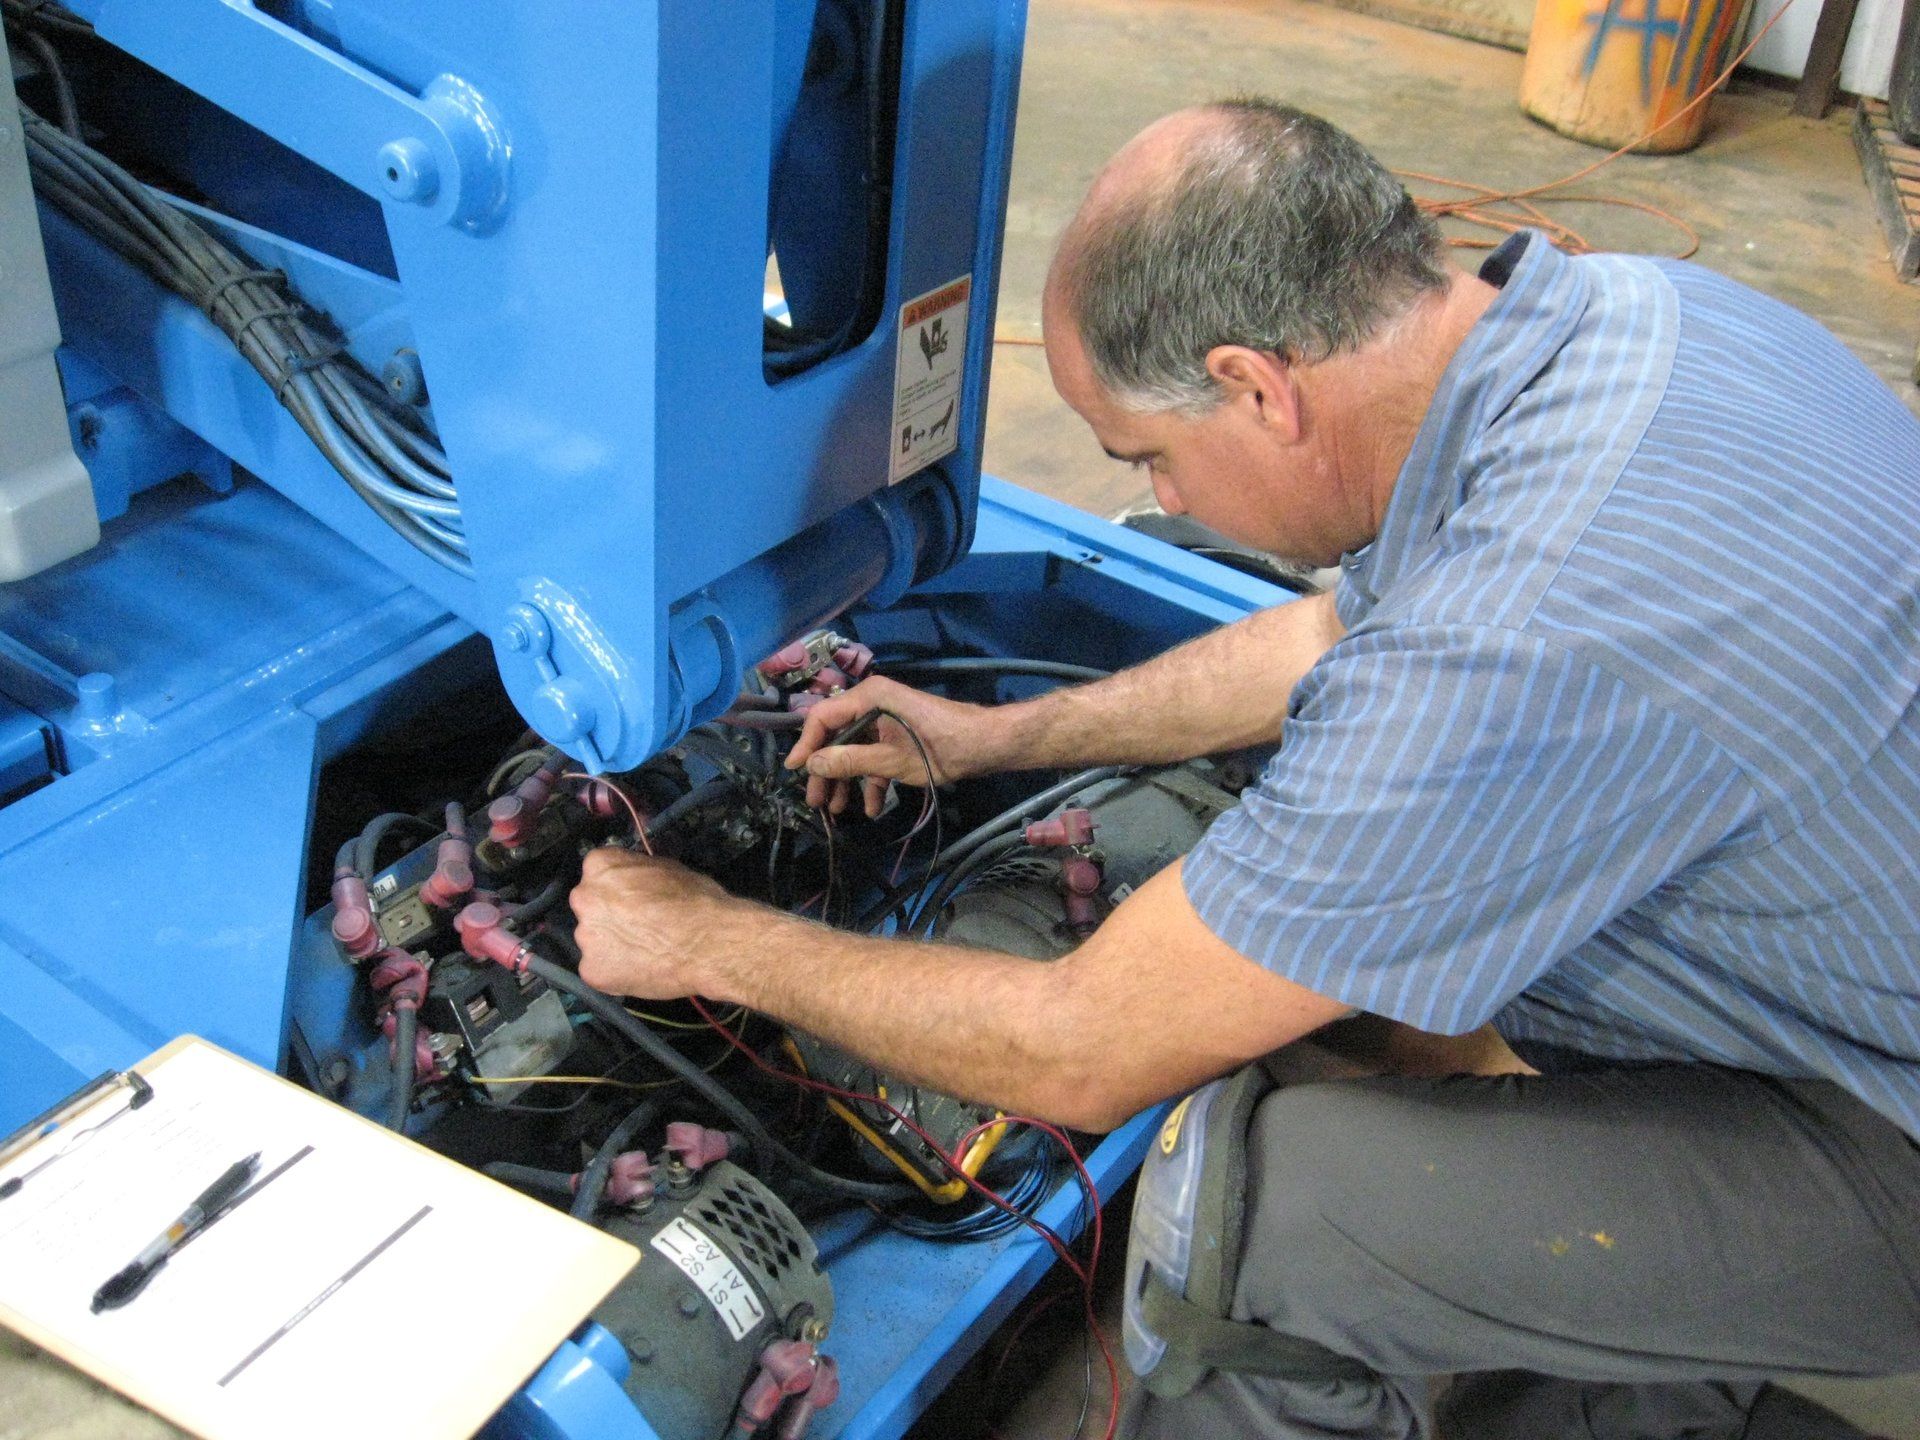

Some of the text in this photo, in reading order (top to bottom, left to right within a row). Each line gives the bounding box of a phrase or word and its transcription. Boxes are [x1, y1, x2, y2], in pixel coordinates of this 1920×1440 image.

[919, 285, 963, 320] WARNING
[681, 1253, 729, 1305] S1 S2
[695, 1239, 744, 1290] A1 A2
